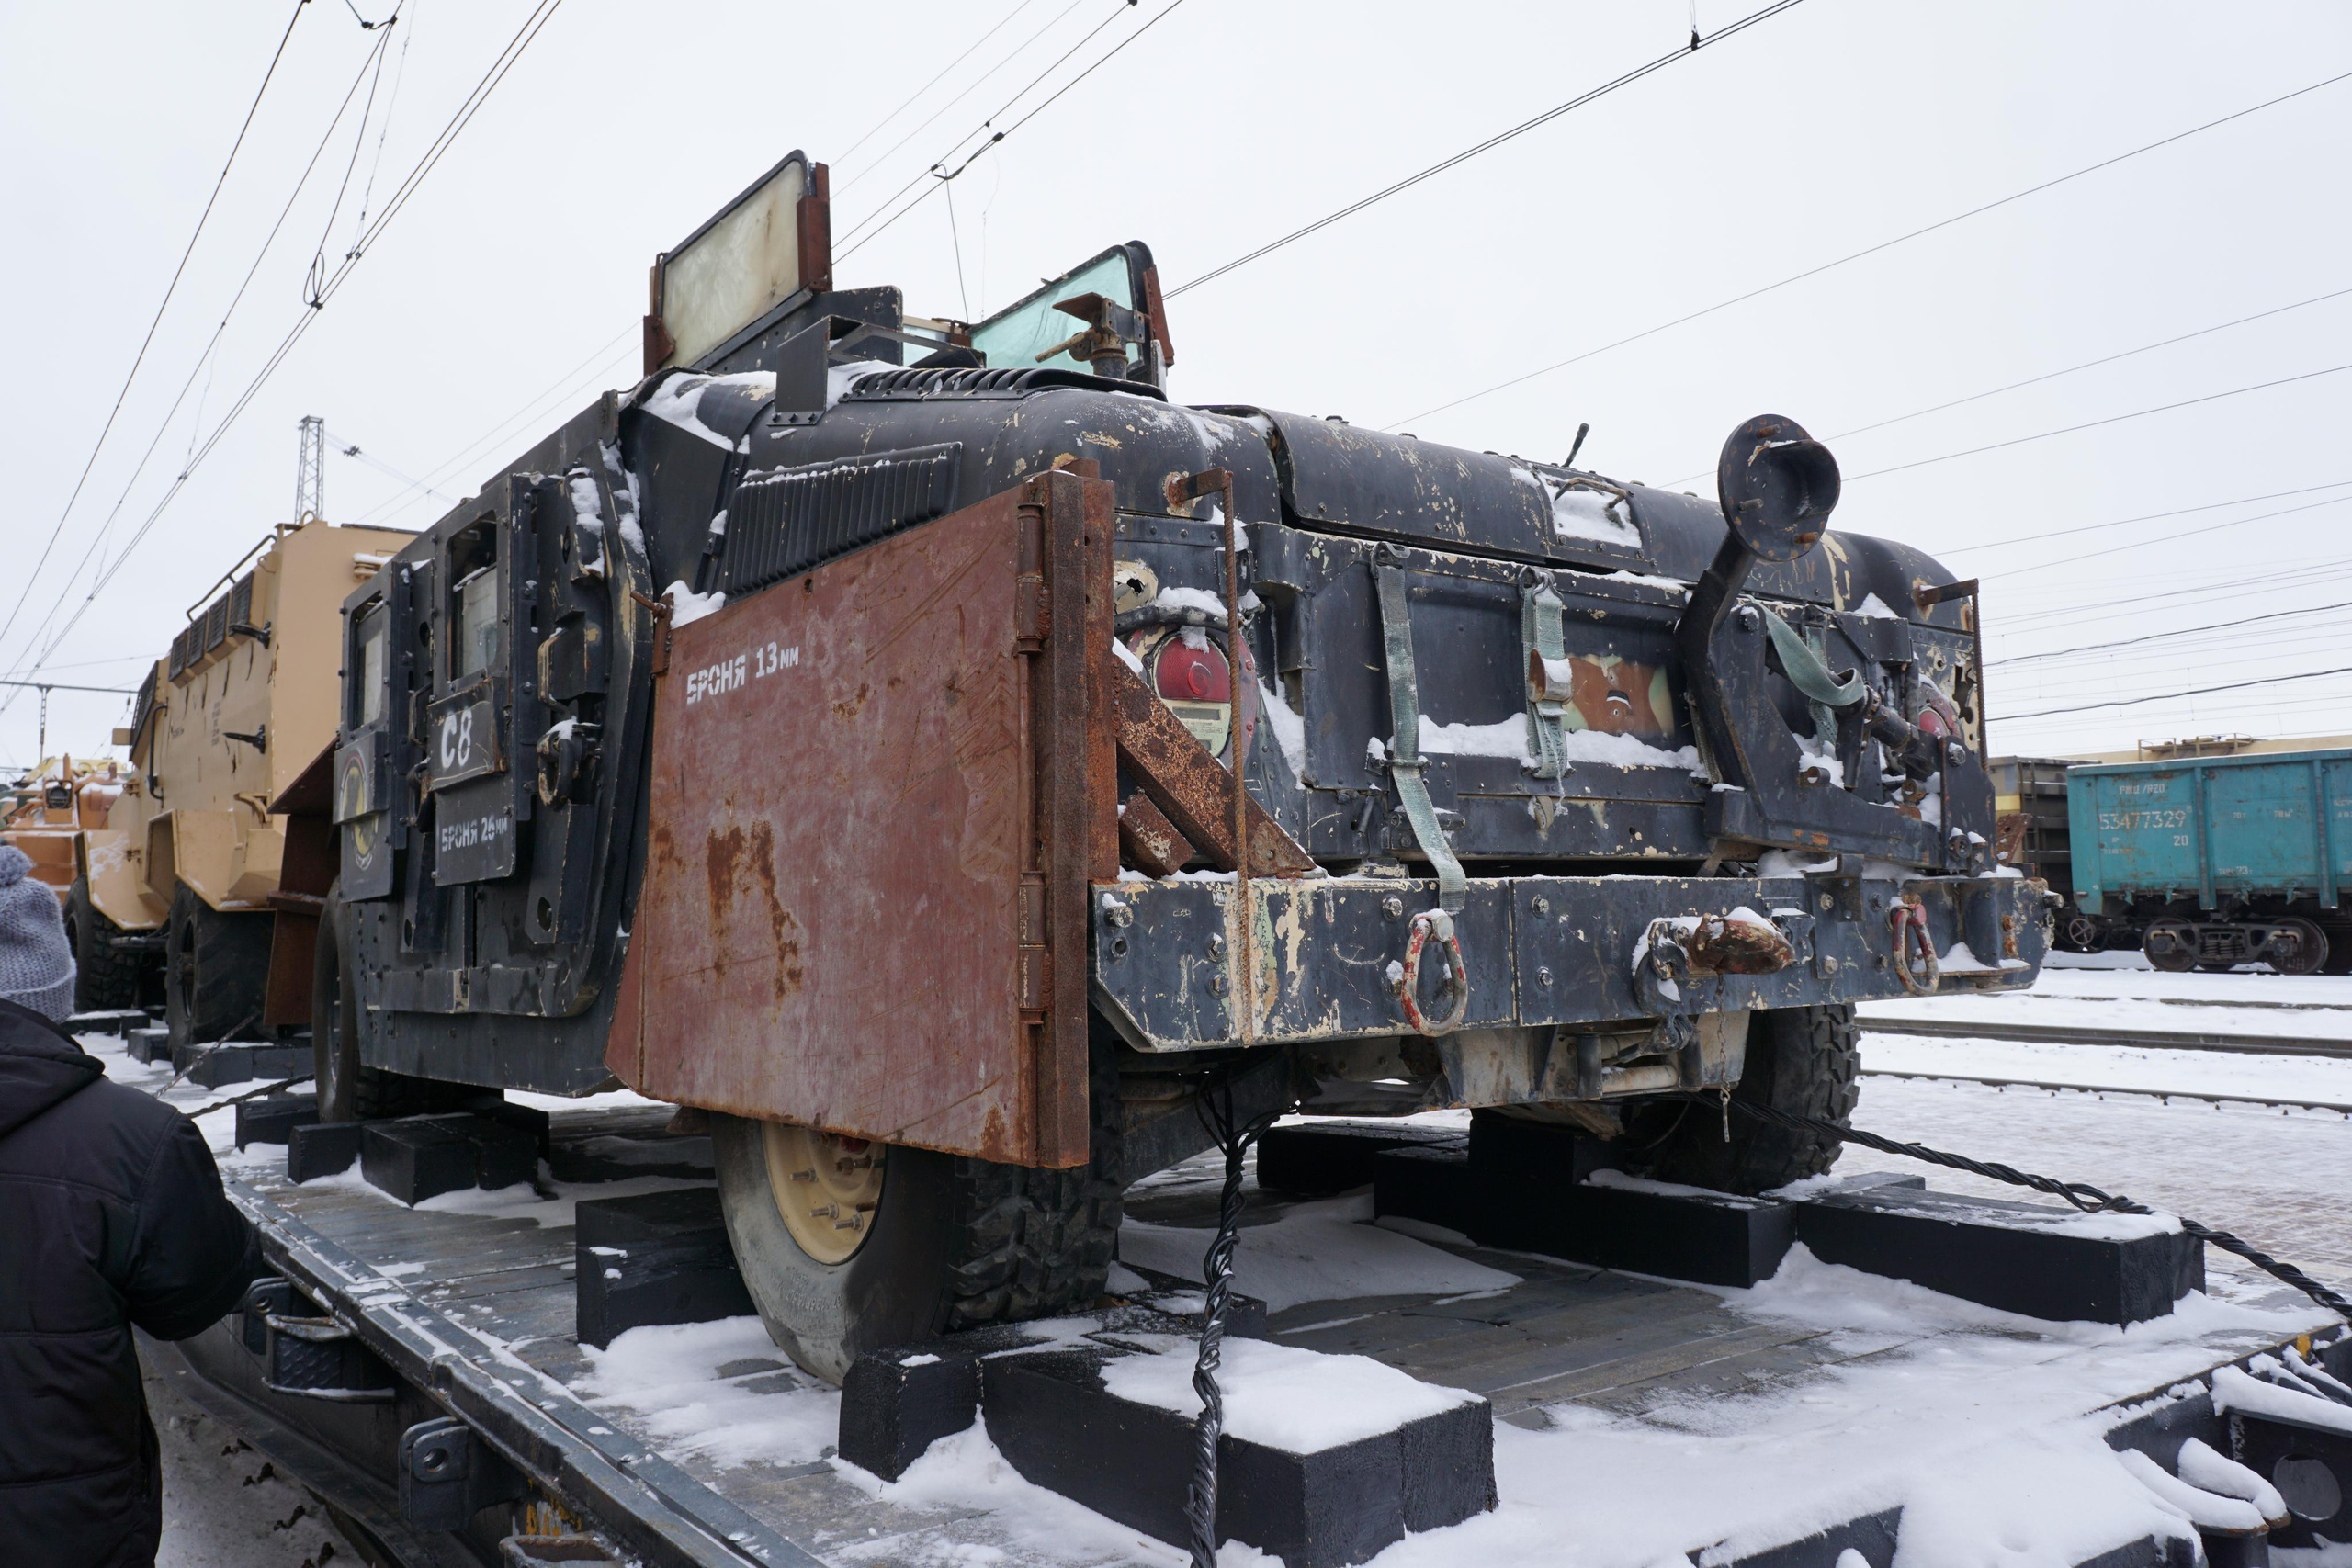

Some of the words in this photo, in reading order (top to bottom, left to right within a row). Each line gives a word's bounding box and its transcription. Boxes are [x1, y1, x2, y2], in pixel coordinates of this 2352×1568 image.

[686, 654, 746, 705] БРОНЯ
[2098, 810, 2187, 830] 53477329
[442, 819, 478, 852] БРОНЯ
[2173, 835, 2189, 847] 20
